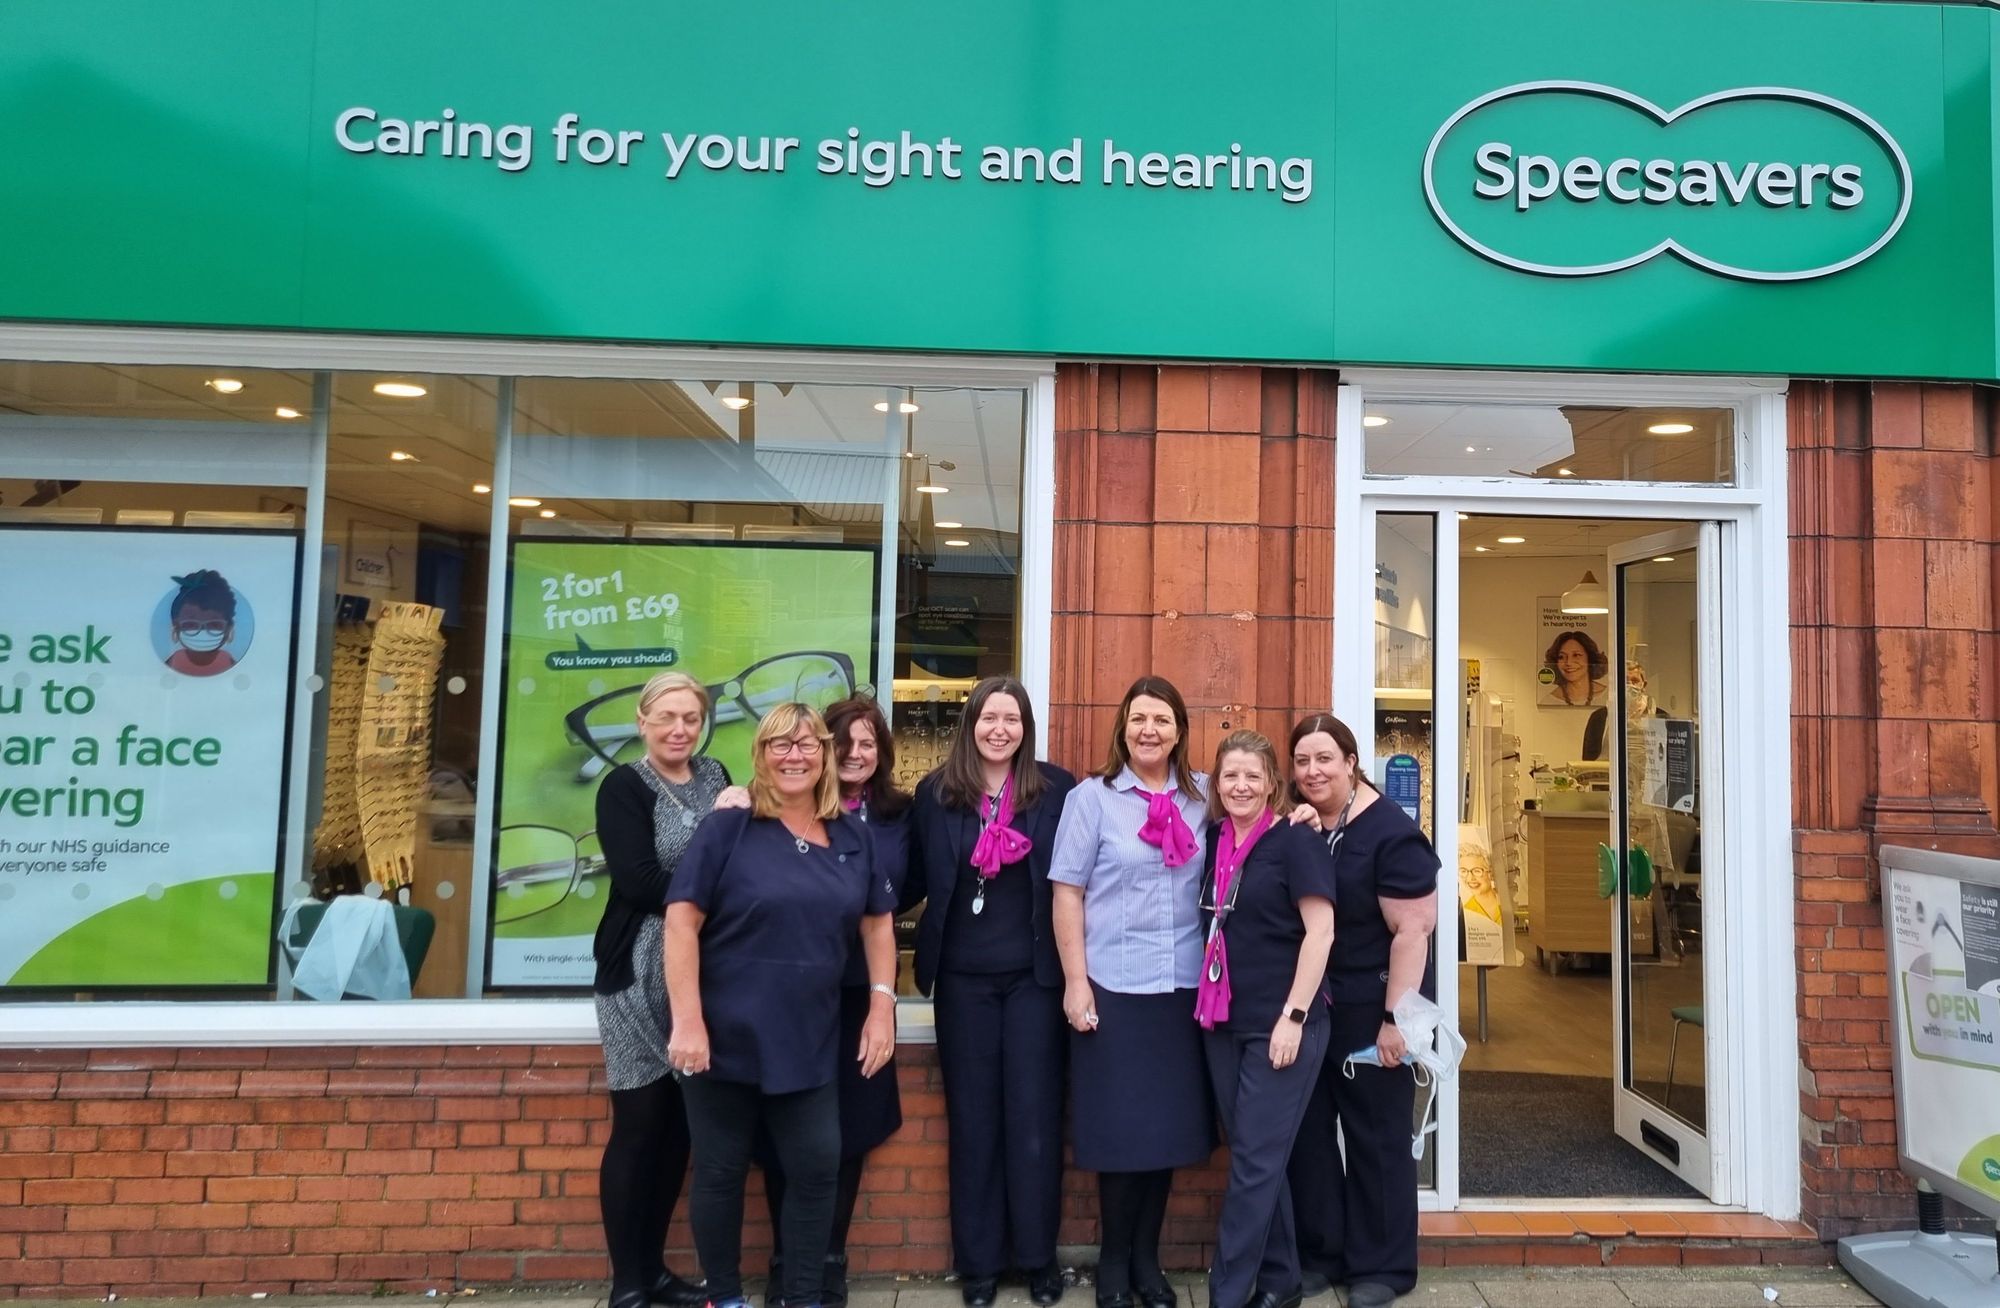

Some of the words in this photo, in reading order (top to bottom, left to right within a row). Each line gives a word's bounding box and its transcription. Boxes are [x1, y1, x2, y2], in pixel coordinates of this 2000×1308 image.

[335, 107, 532, 171] Caring
[552, 113, 644, 165] for
[662, 131, 799, 178] your
[817, 127, 962, 186] sight
[980, 138, 1082, 184] and
[1103, 139, 1313, 202] hearing
[1474, 142, 1864, 211] Specsavers
[541, 578, 560, 601] 2
[562, 573, 608, 599] for
[611, 570, 624, 593] 1
[544, 604, 618, 630] from
[626, 593, 680, 621] £69
[29, 625, 112, 664] ask
[552, 656, 574, 667] You
[576, 655, 608, 666] know
[610, 655, 631, 667] you
[634, 652, 672, 664] should
[41, 679, 96, 714] to
[0, 736, 56, 766] ar
[72, 736, 99, 766] a
[116, 724, 222, 767] face
[16, 842, 47, 853] our
[51, 839, 87, 853] NHS
[92, 838, 170, 856] guidance
[72, 857, 107, 872] safe
[1974, 905, 1995, 917] priority
[524, 954, 545, 963] With
[1926, 992, 1981, 1024] OPEN
[1922, 1023, 1942, 1037] with
[1960, 1027, 1968, 1040] in
[1970, 1029, 1993, 1044] mind
